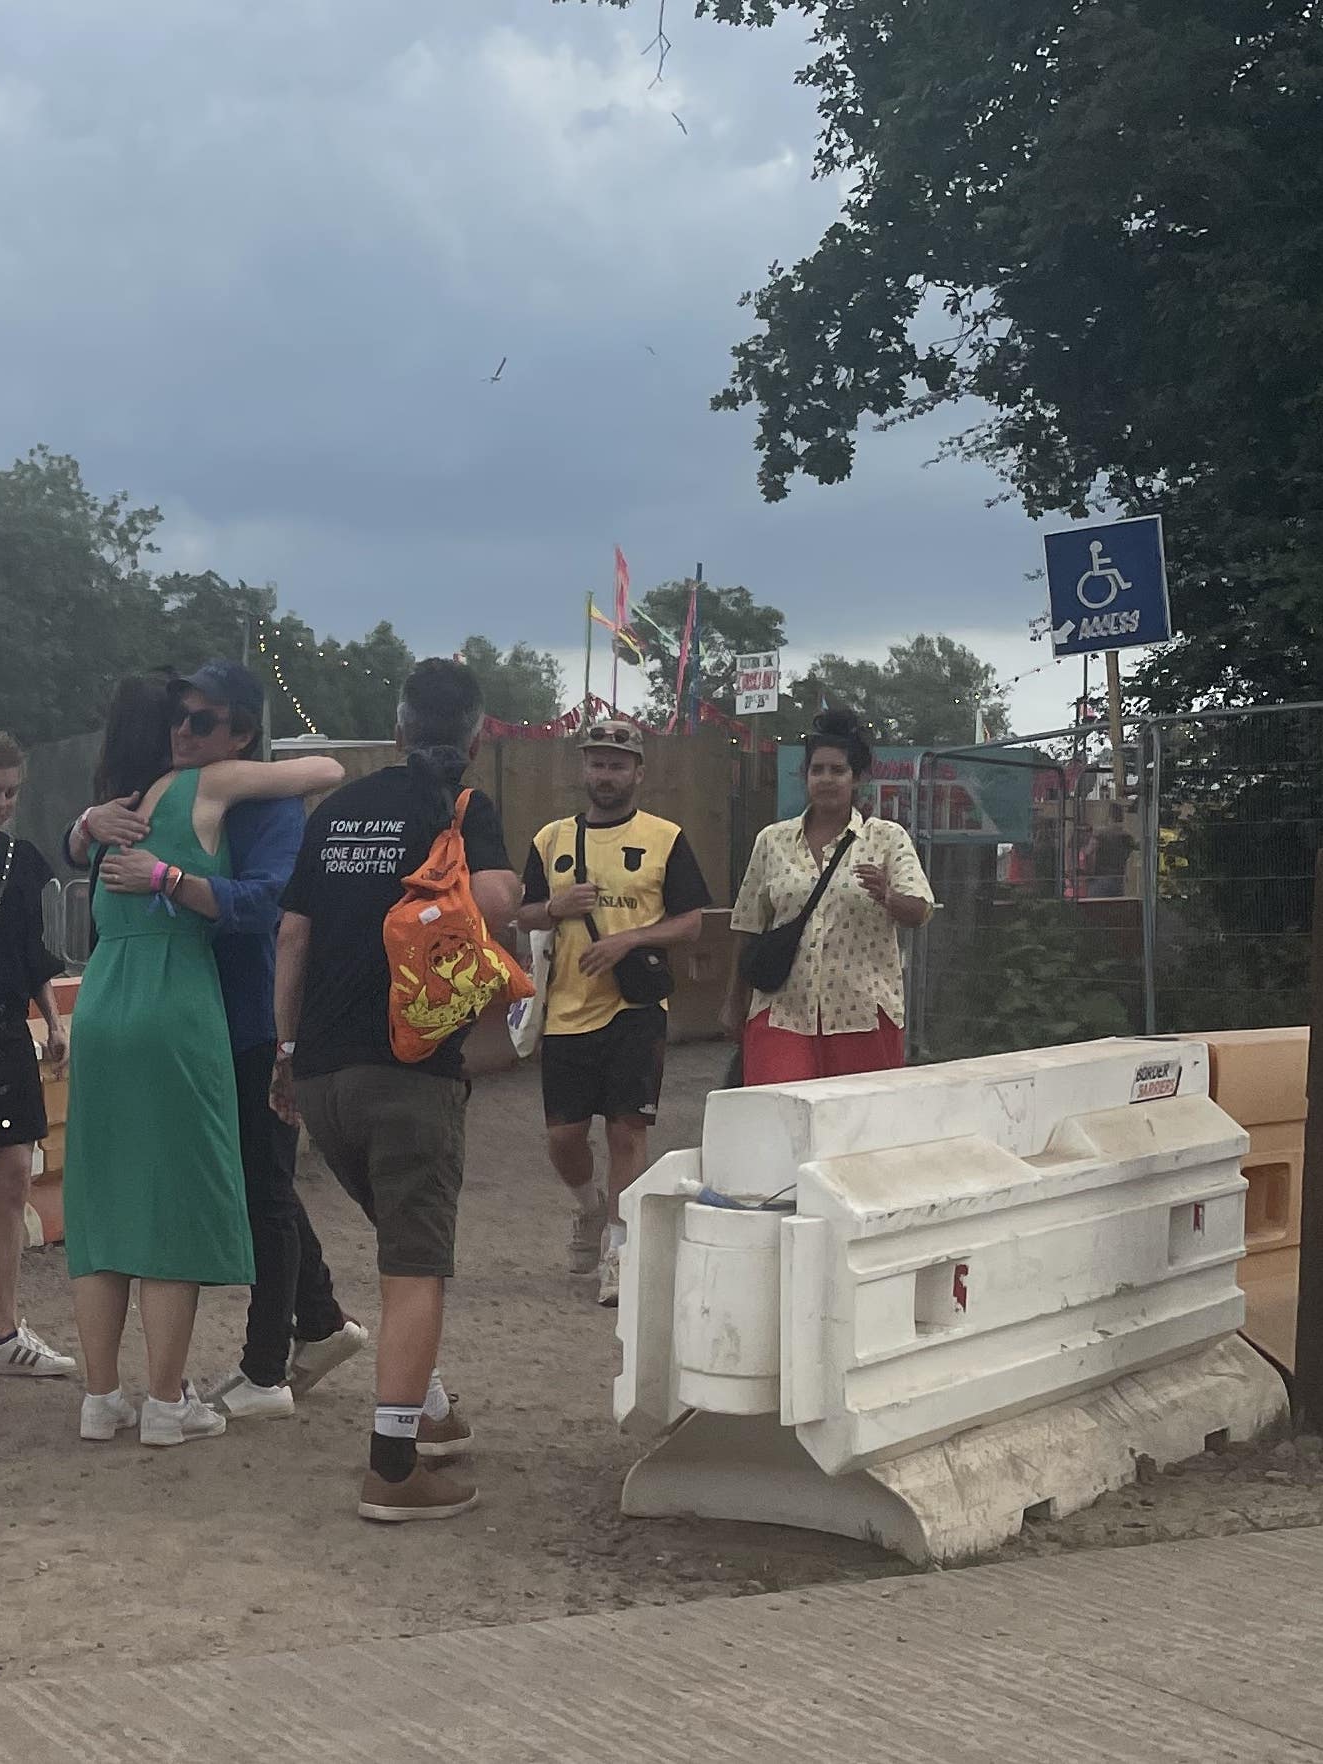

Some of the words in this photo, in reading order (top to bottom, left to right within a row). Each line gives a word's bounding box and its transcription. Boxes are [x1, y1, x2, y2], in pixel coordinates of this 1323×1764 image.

[1078, 609, 1140, 640] ACCESS
[330, 820, 363, 833] TONY
[364, 821, 405, 833] PAYNE
[321, 847, 350, 860] GONE
[352, 847, 375, 860] BUT
[378, 847, 406, 860] NOT
[325, 860, 397, 874] FORGOTTEN
[598, 896, 638, 909] ISLAND
[1135, 1063, 1170, 1082] BORDER
